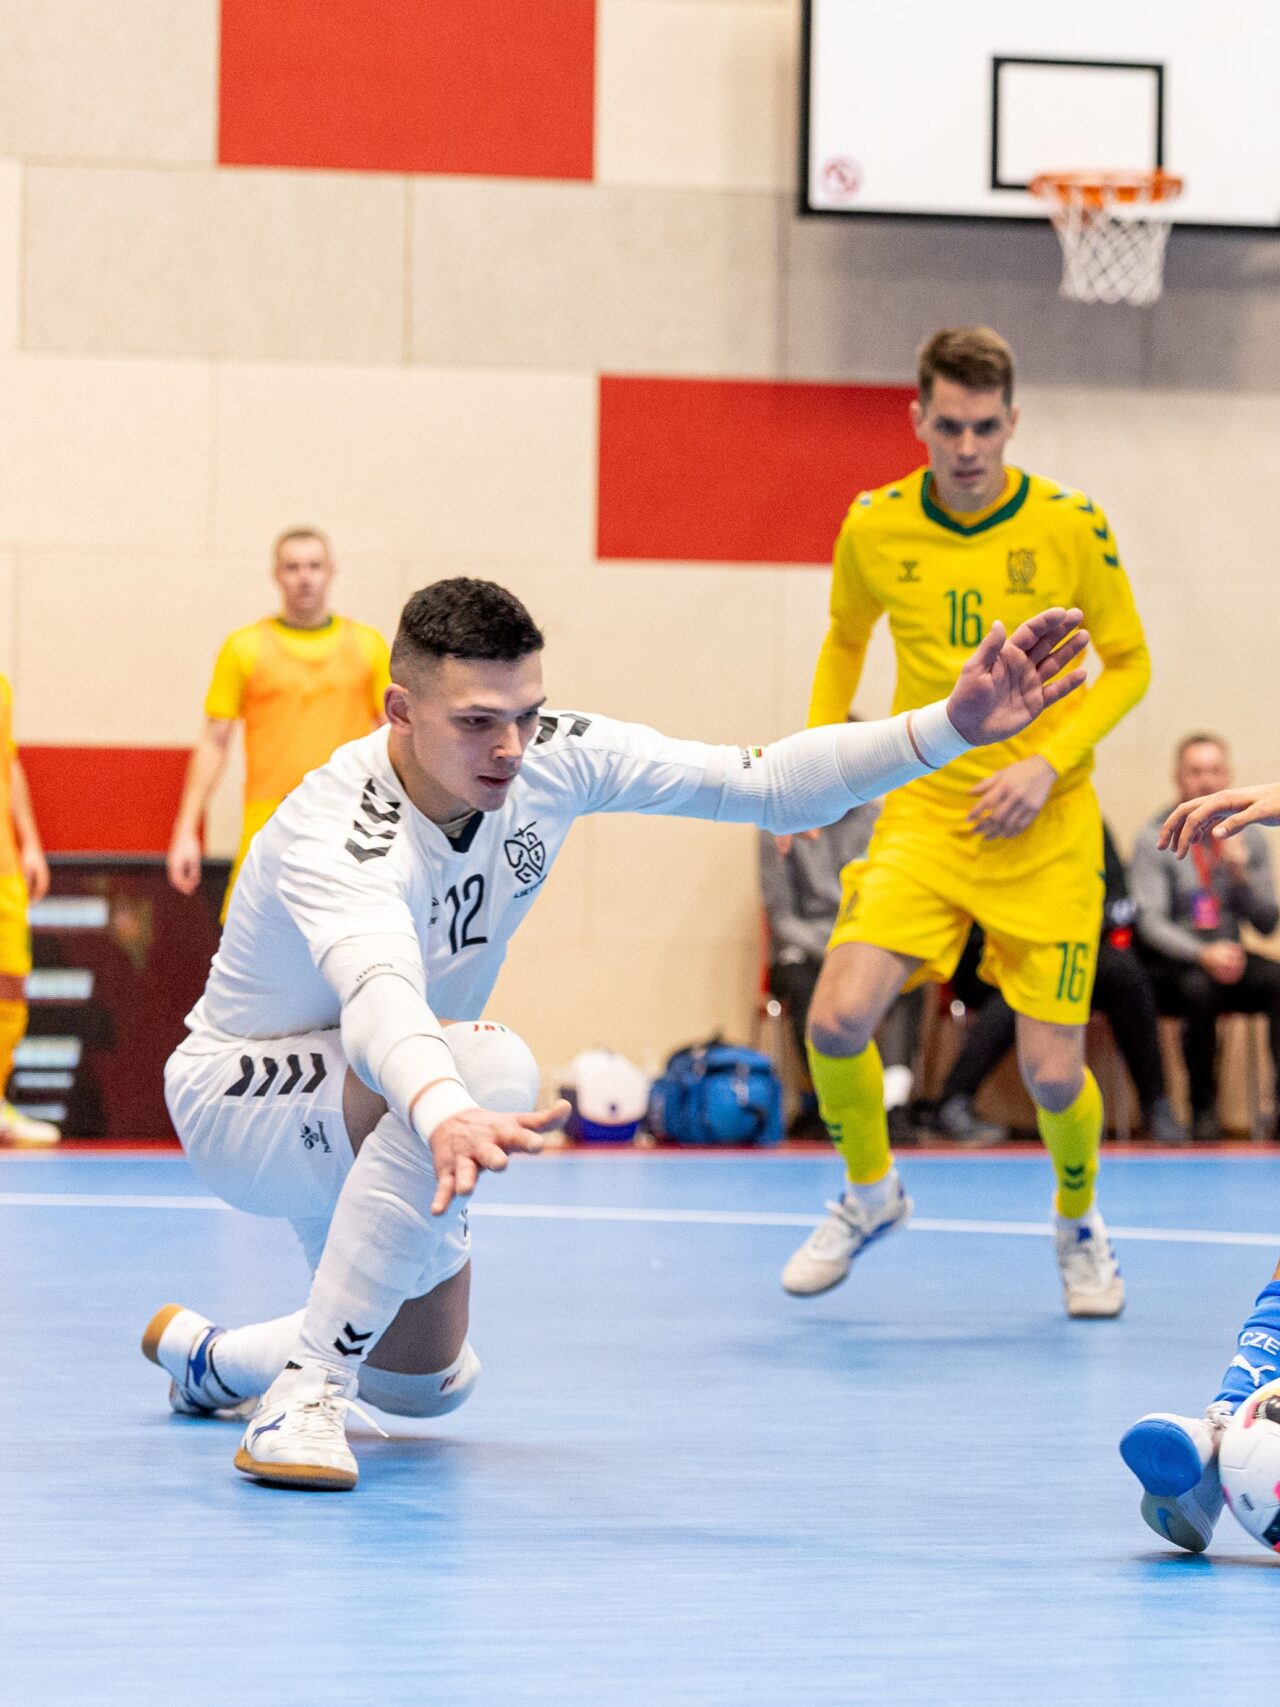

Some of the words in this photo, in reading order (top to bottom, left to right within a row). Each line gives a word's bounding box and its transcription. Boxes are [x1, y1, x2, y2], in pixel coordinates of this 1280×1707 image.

[944, 588, 983, 648] 16
[444, 873, 489, 956] 12
[1056, 942, 1088, 1003] 16
